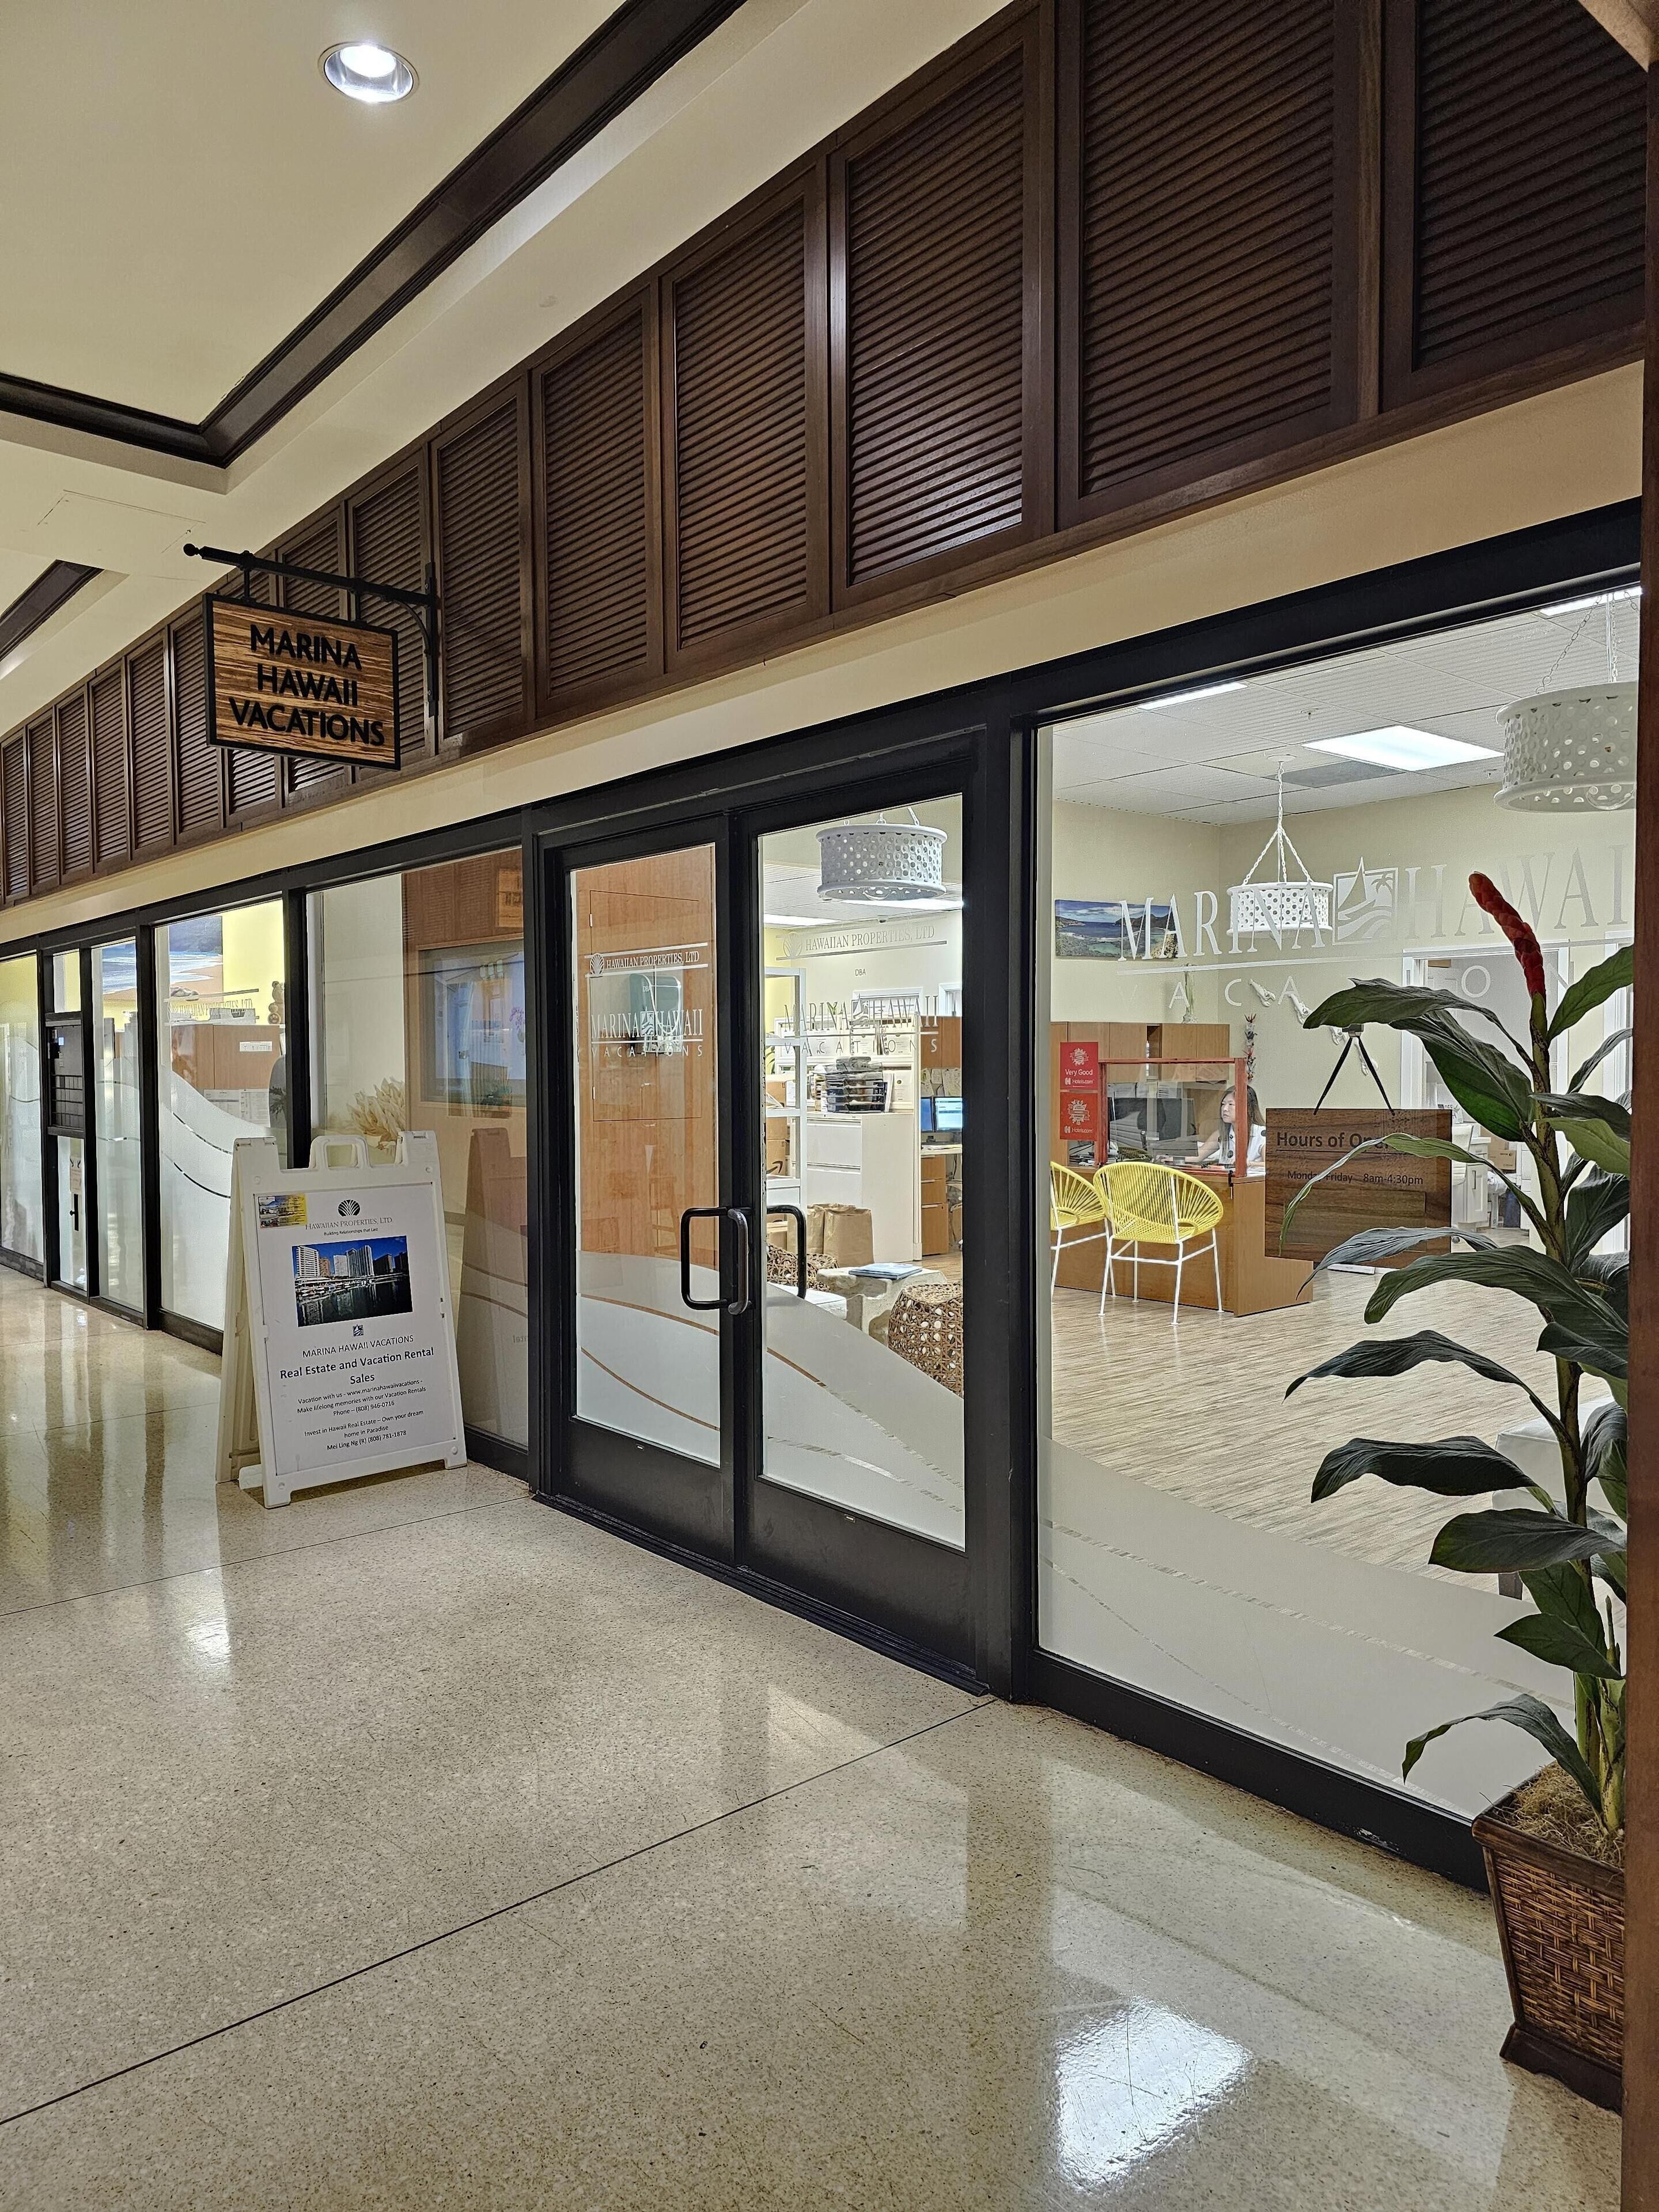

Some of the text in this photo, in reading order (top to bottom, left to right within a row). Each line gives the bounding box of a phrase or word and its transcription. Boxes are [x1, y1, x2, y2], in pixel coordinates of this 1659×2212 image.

[250, 624, 362, 670] MARINA
[257, 664, 358, 706] HAWAII
[228, 698, 385, 746] VACATIONS
[1118, 880, 1325, 961] MARINA
[805, 935, 849, 951] HAWAIIAN
[915, 925, 935, 940] LTD
[607, 957, 639, 968] HAWAIIAN
[685, 950, 700, 963] LTD
[855, 968, 866, 976] DBA
[784, 995, 939, 1032] MARINA HAWAII
[591, 1012, 640, 1039] MARINA
[784, 1039, 937, 1055] VACATIONS
[1277, 1132, 1323, 1148] Hours
[1327, 1132, 1345, 1148] of
[1363, 1173, 1423, 1185] 8am-4:30pm
[305, 1221, 339, 1230] HAWAIIAN
[302, 1335, 414, 1358] MARINA HAWAII VACATIONS
[280, 1346, 434, 1379] Real Estate and Vacation Rental
[350, 1373, 375, 1385] Sales
[298, 1396, 322, 1404] Vacation
[314, 1403, 334, 1411] lifelong
[335, 1398, 361, 1407] memories
[384, 1390, 407, 1398] Vacation
[408, 1386, 426, 1394] Rentals
[333, 1408, 350, 1416] Phone
[370, 1400, 395, 1410] 946-0716
[328, 1424, 347, 1433] Hawaii
[347, 1421, 359, 1429] Real
[360, 1418, 376, 1426] Estate
[394, 1413, 407, 1422] your
[407, 1410, 424, 1418] dream
[366, 1425, 389, 1434] Paradise
[327, 1442, 338, 1450] Mei
[339, 1441, 350, 1449] Ling
[359, 1437, 367, 1445] (R)
[368, 1435, 382, 1444] (808)
[382, 1430, 407, 1440] 781-1878
